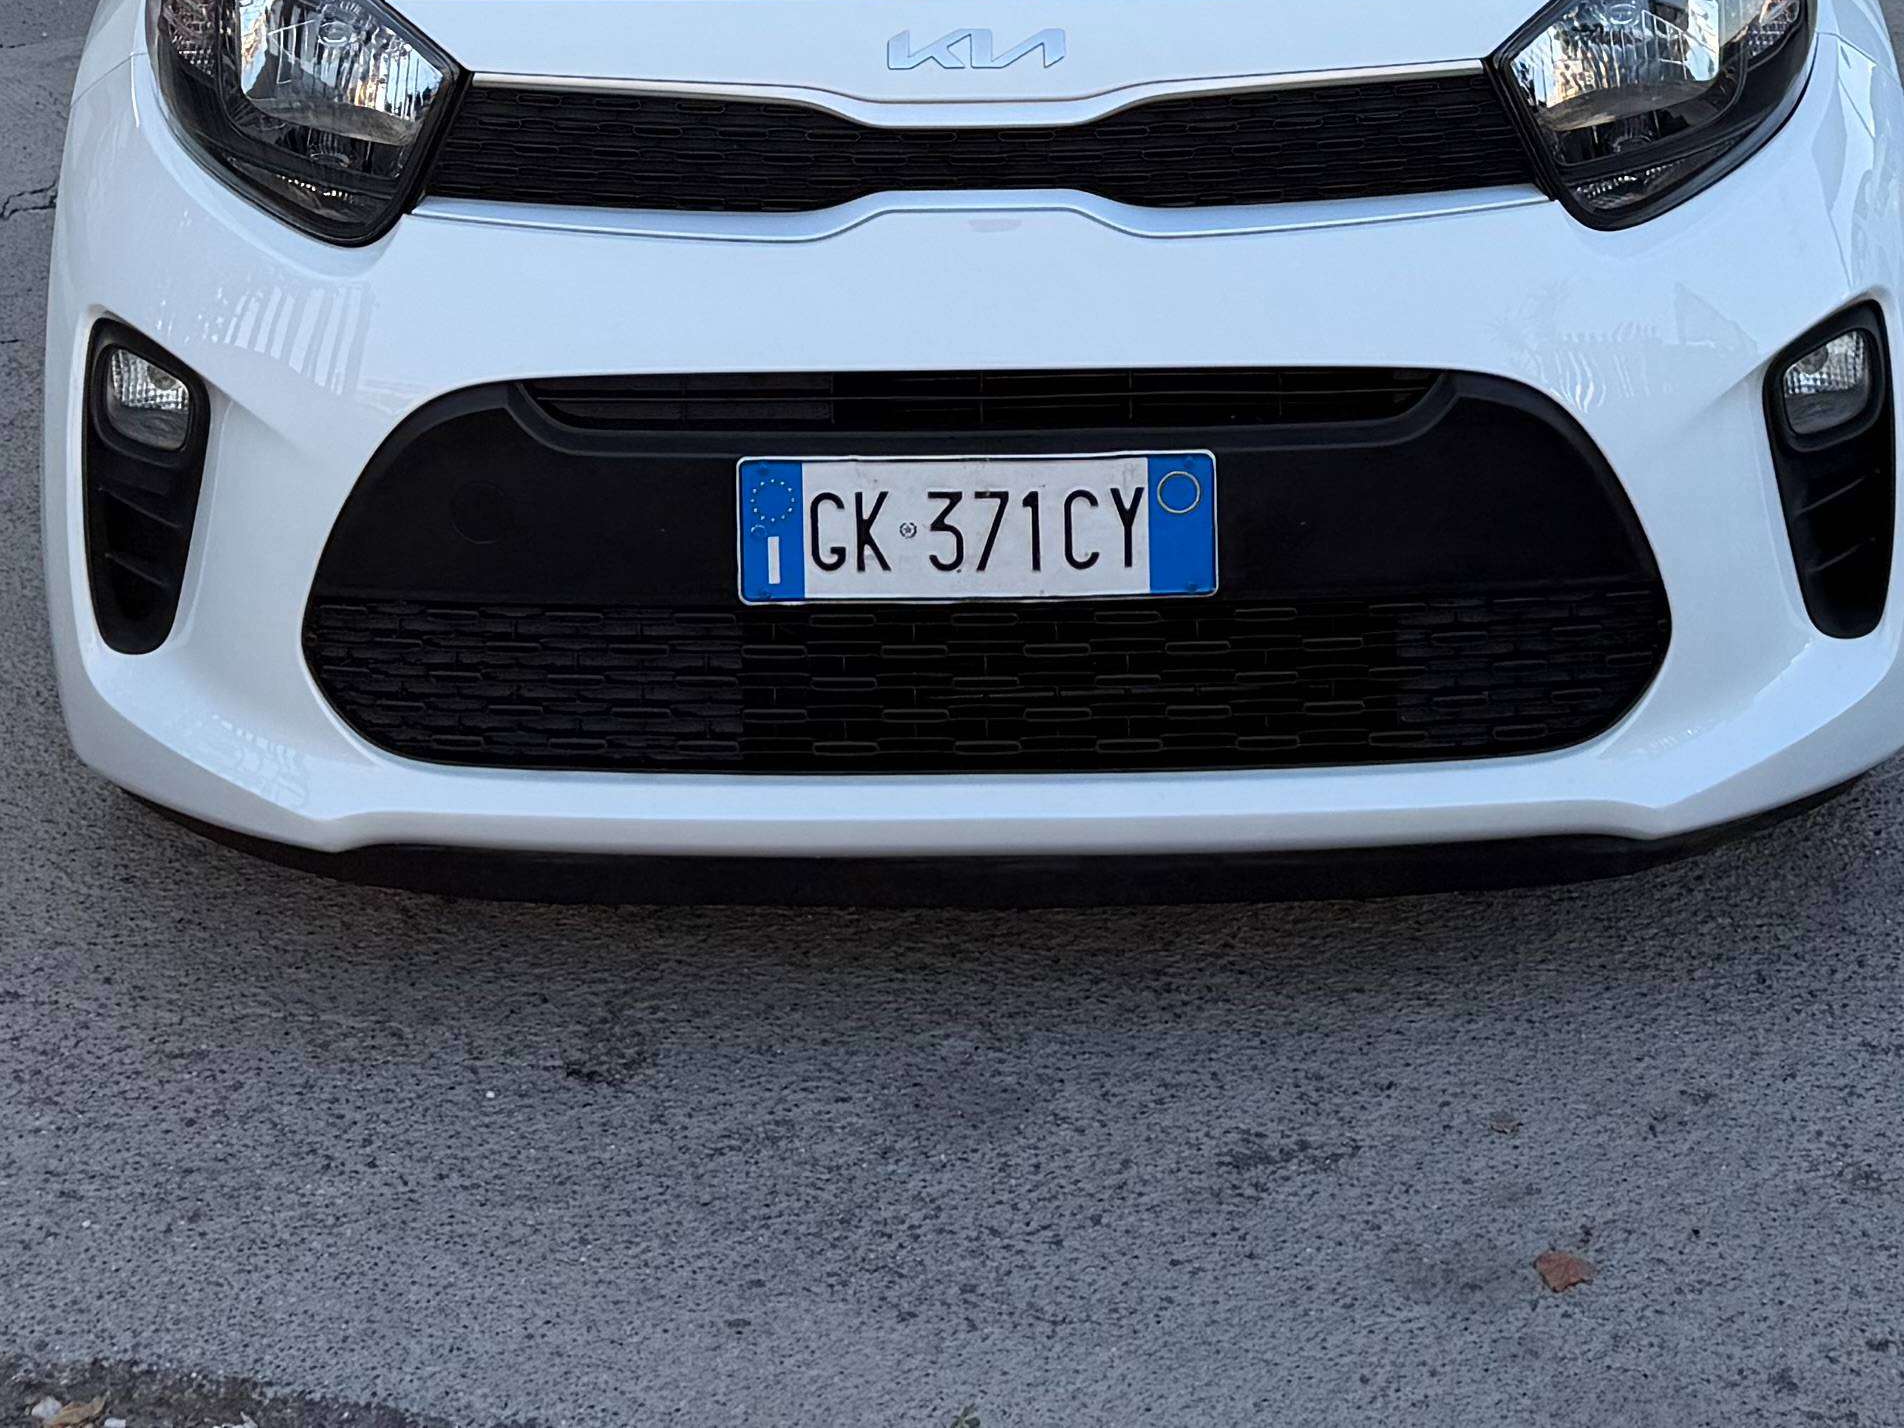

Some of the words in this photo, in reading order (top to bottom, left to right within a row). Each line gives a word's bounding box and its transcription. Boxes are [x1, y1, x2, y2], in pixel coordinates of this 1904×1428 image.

[887, 28, 1066, 70] KIA
[809, 491, 892, 572] GK
[926, 486, 1145, 573] 371CY
